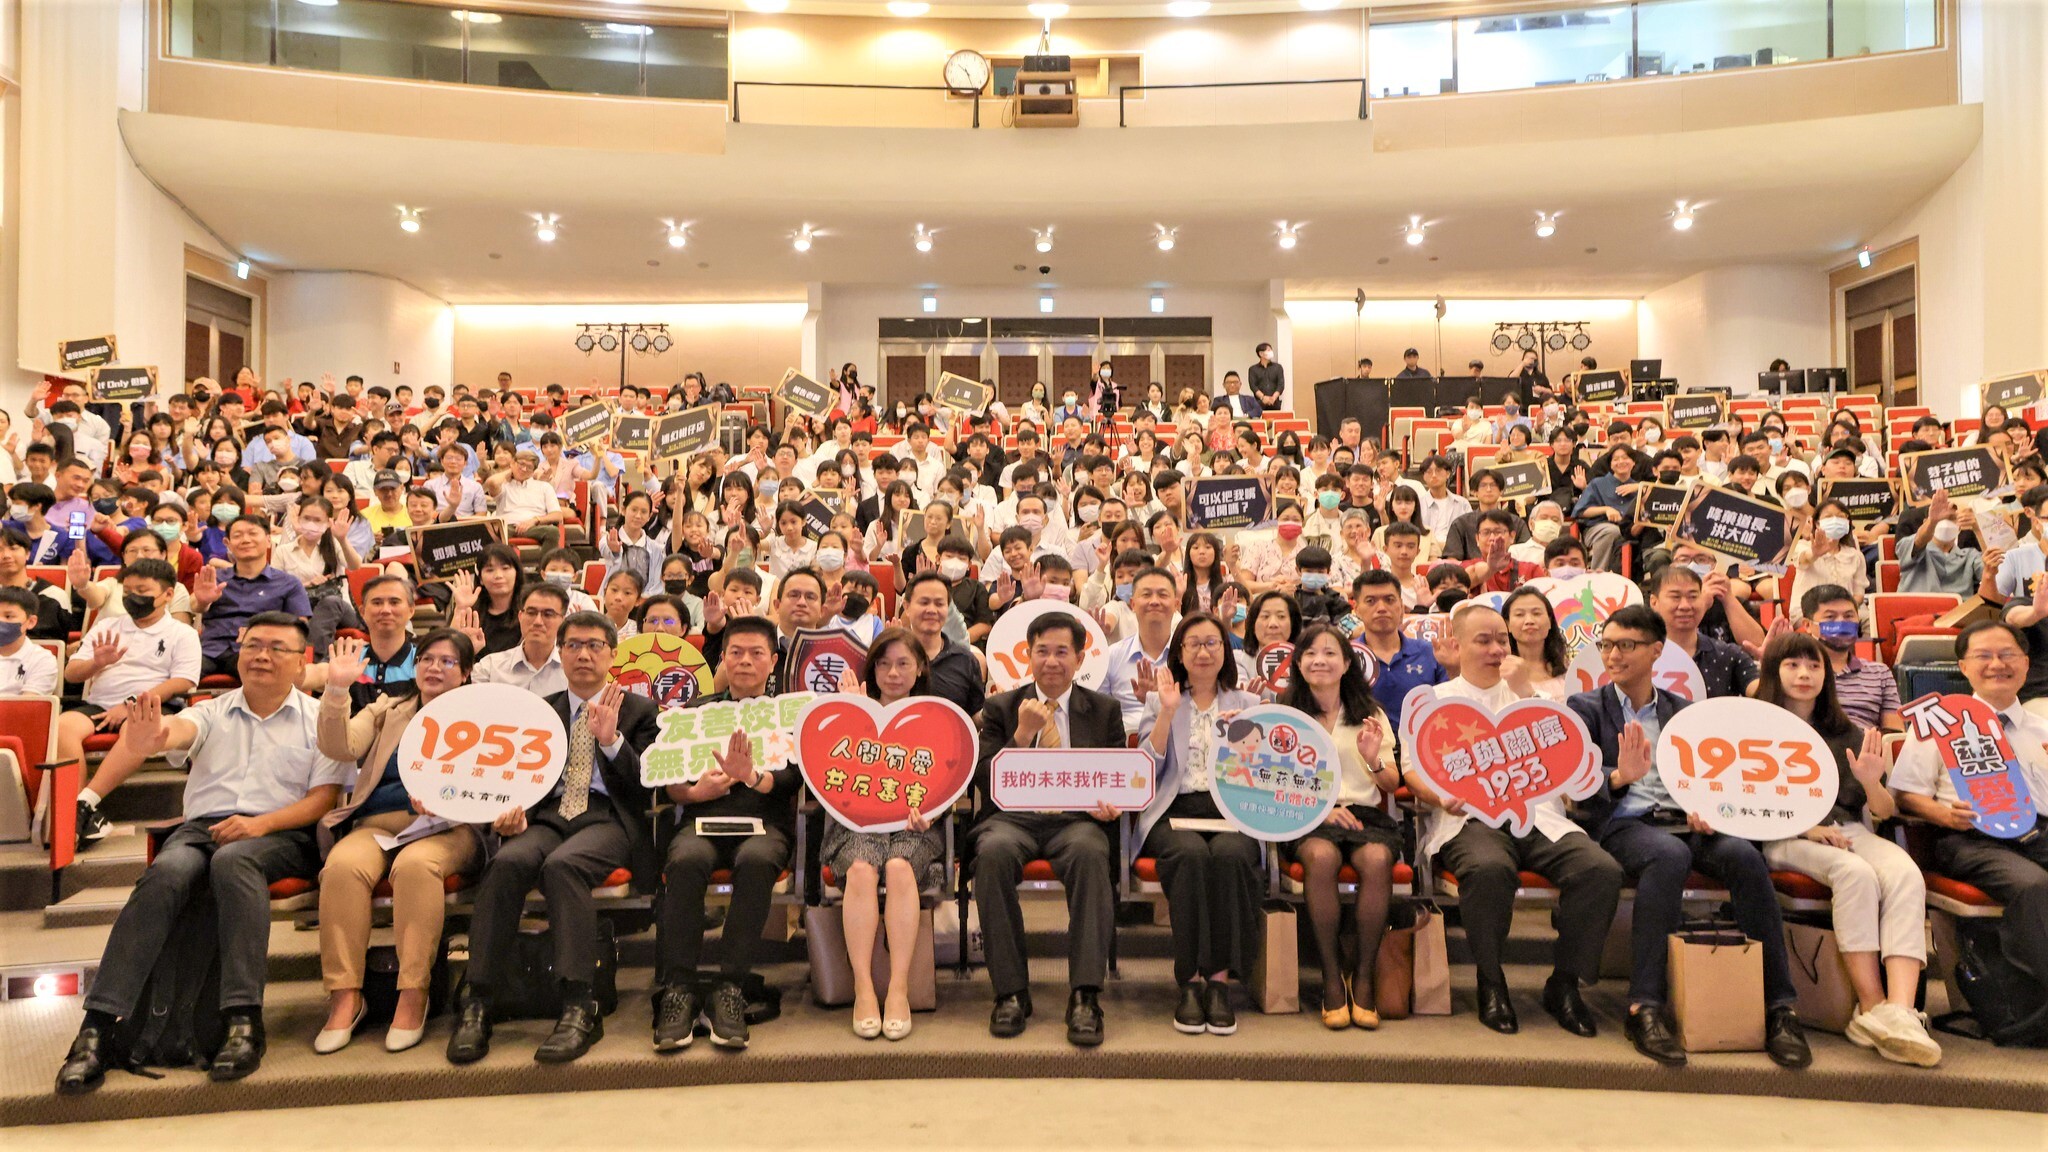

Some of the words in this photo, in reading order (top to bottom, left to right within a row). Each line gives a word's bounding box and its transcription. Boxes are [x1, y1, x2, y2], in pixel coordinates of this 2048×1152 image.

[107, 379, 130, 389] Only
[1710, 522, 1757, 546] 洪大仙
[433, 545, 458, 561] 如果
[458, 539, 483, 554] 可以
[660, 672, 694, 707] 毒
[661, 696, 814, 744] 友善校園
[421, 715, 553, 772] 1953
[830, 737, 934, 776] 人間有愛
[1441, 714, 1569, 782] 愛與關懷
[409, 760, 546, 786] 反霸凌專線
[1670, 735, 1821, 785] 1953
[824, 767, 928, 808] 共反毒害
[1001, 770, 1127, 789] 我的未來我作主
[1477, 757, 1552, 804] 1953
[1676, 778, 1825, 799] 反霸凌專線
[459, 789, 512, 803] 教育部
[1738, 806, 1795, 820] 教育部
